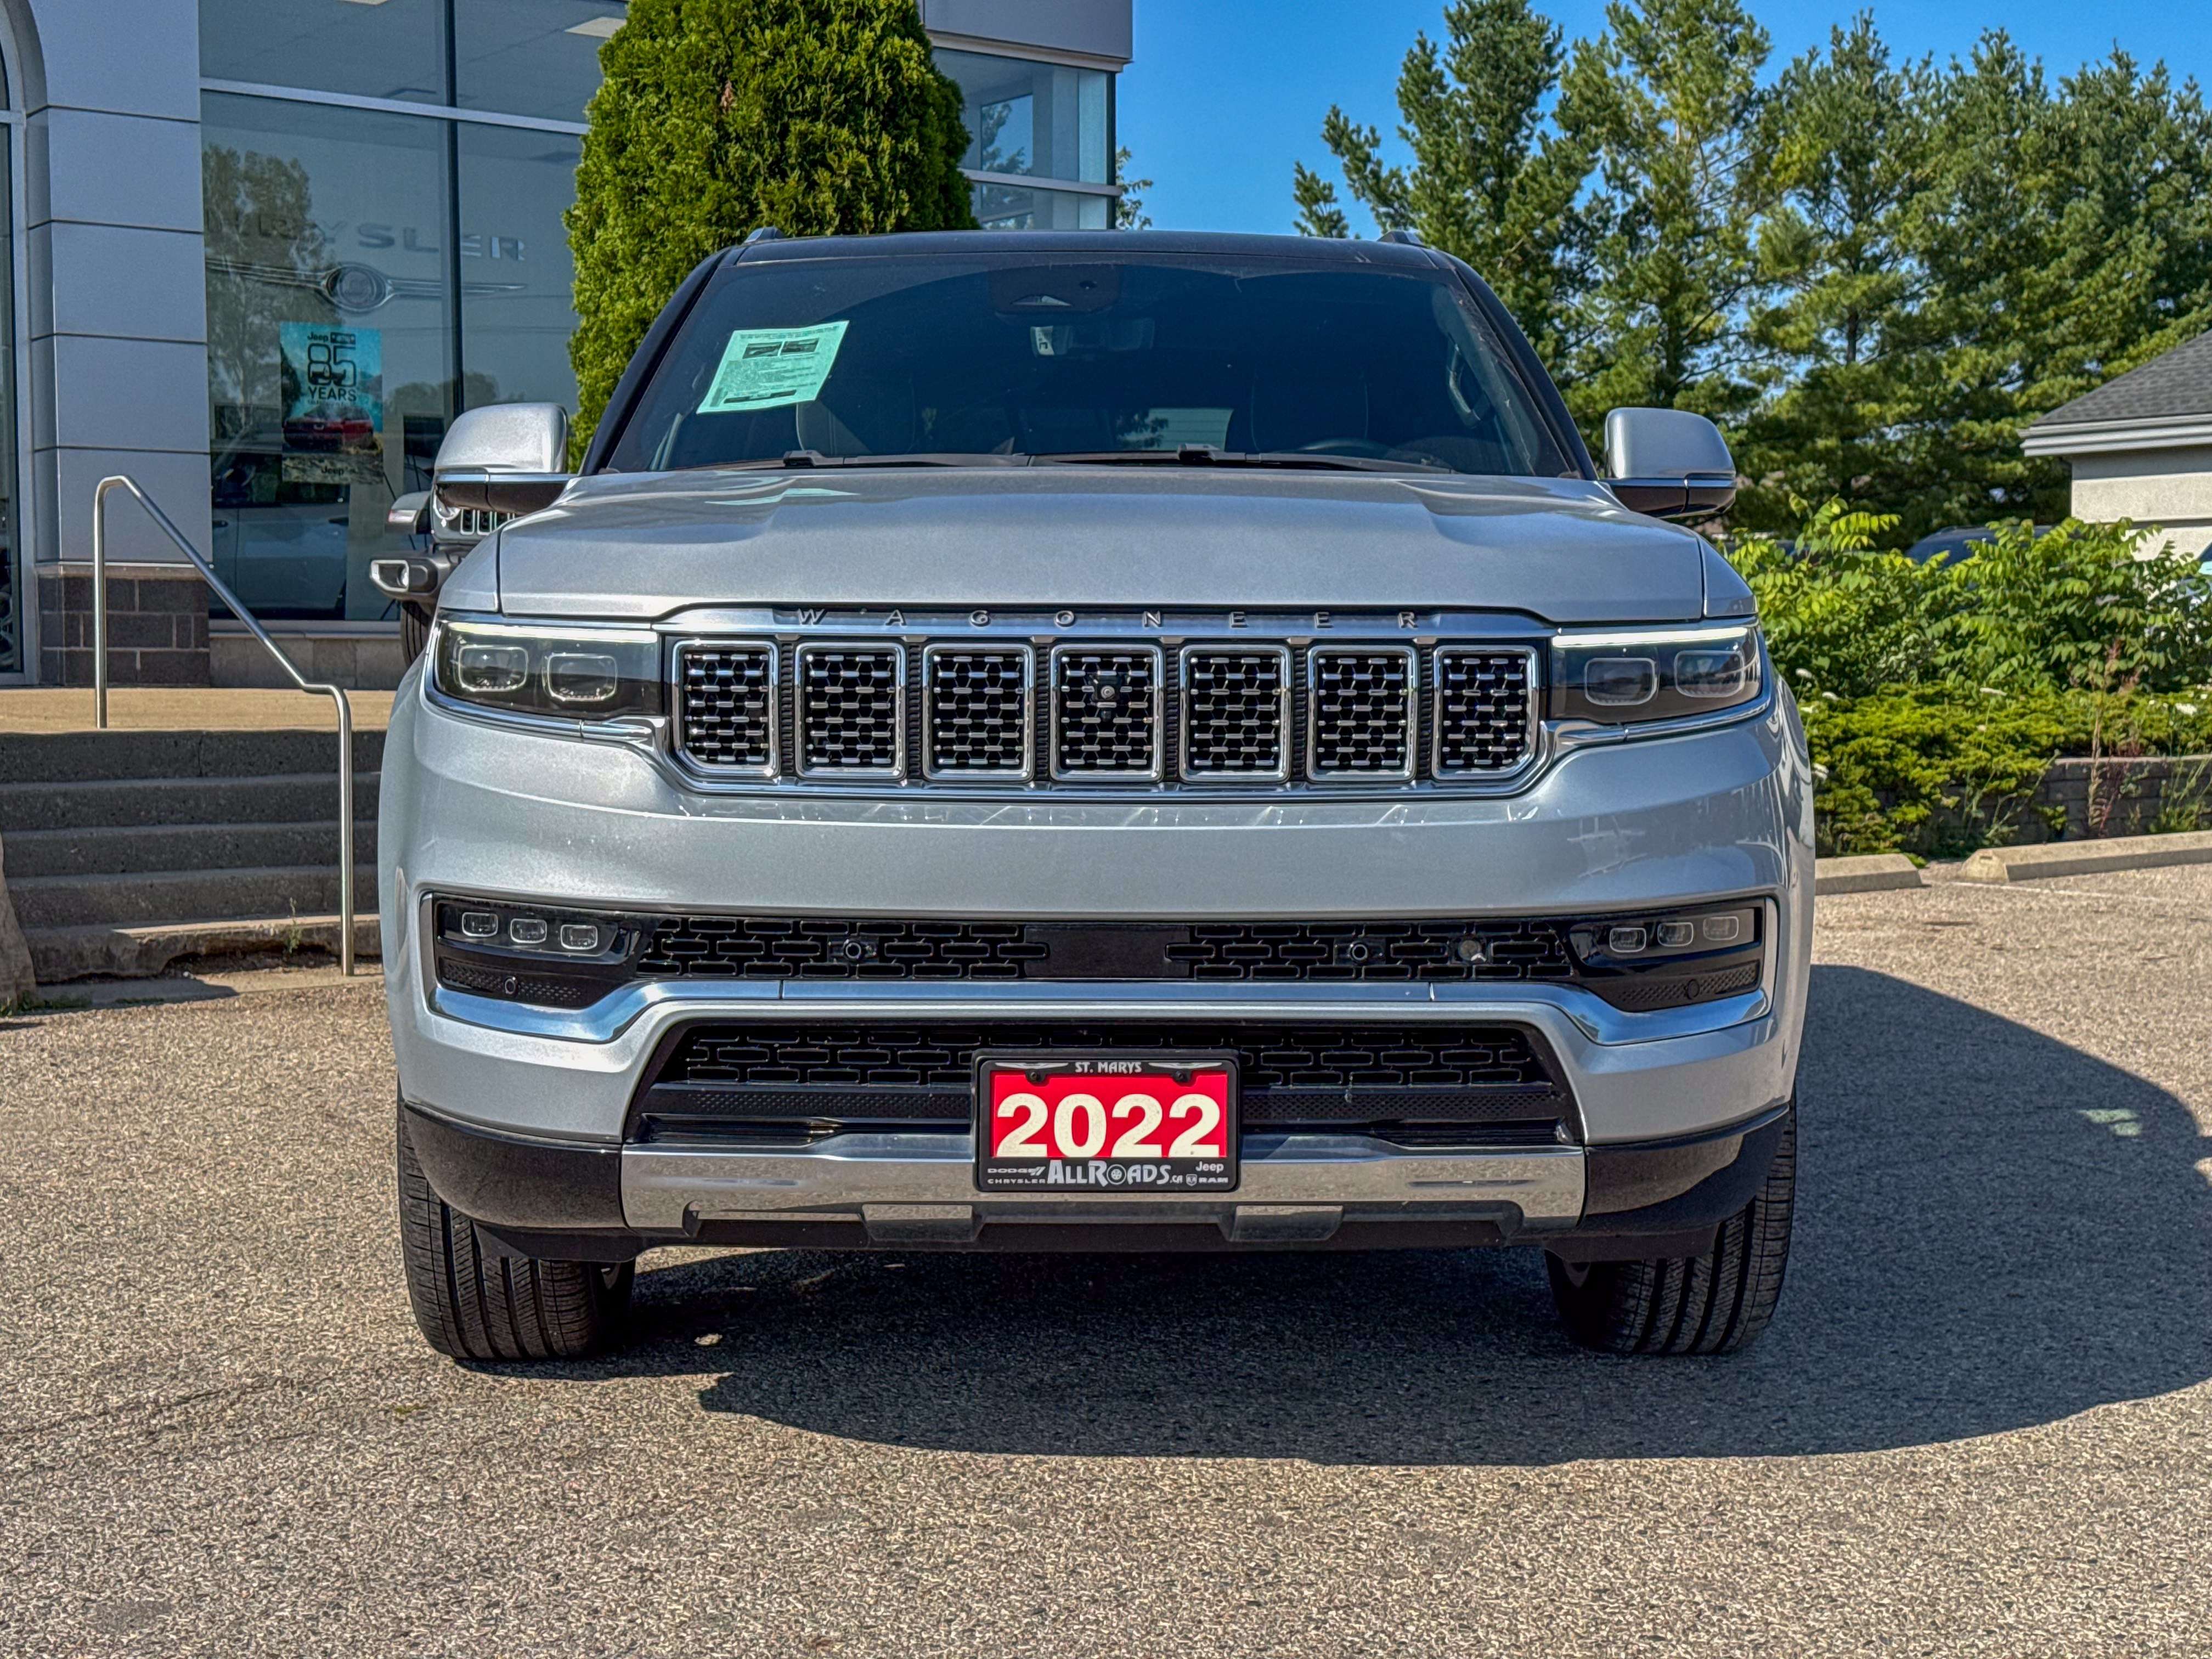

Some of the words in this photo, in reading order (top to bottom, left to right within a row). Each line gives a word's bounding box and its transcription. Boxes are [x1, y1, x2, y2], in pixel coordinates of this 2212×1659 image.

[307, 332, 329, 342] Jeep
[308, 343, 357, 386] 85
[308, 387, 357, 402] YEARS
[321, 466, 345, 476] Jeep
[797, 608, 1419, 629] WAGONEER
[1075, 1062, 1093, 1073] ST.
[1098, 1062, 1142, 1074] MARYS
[997, 1093, 1221, 1157] 2022
[1195, 1161, 1224, 1173] Jeep
